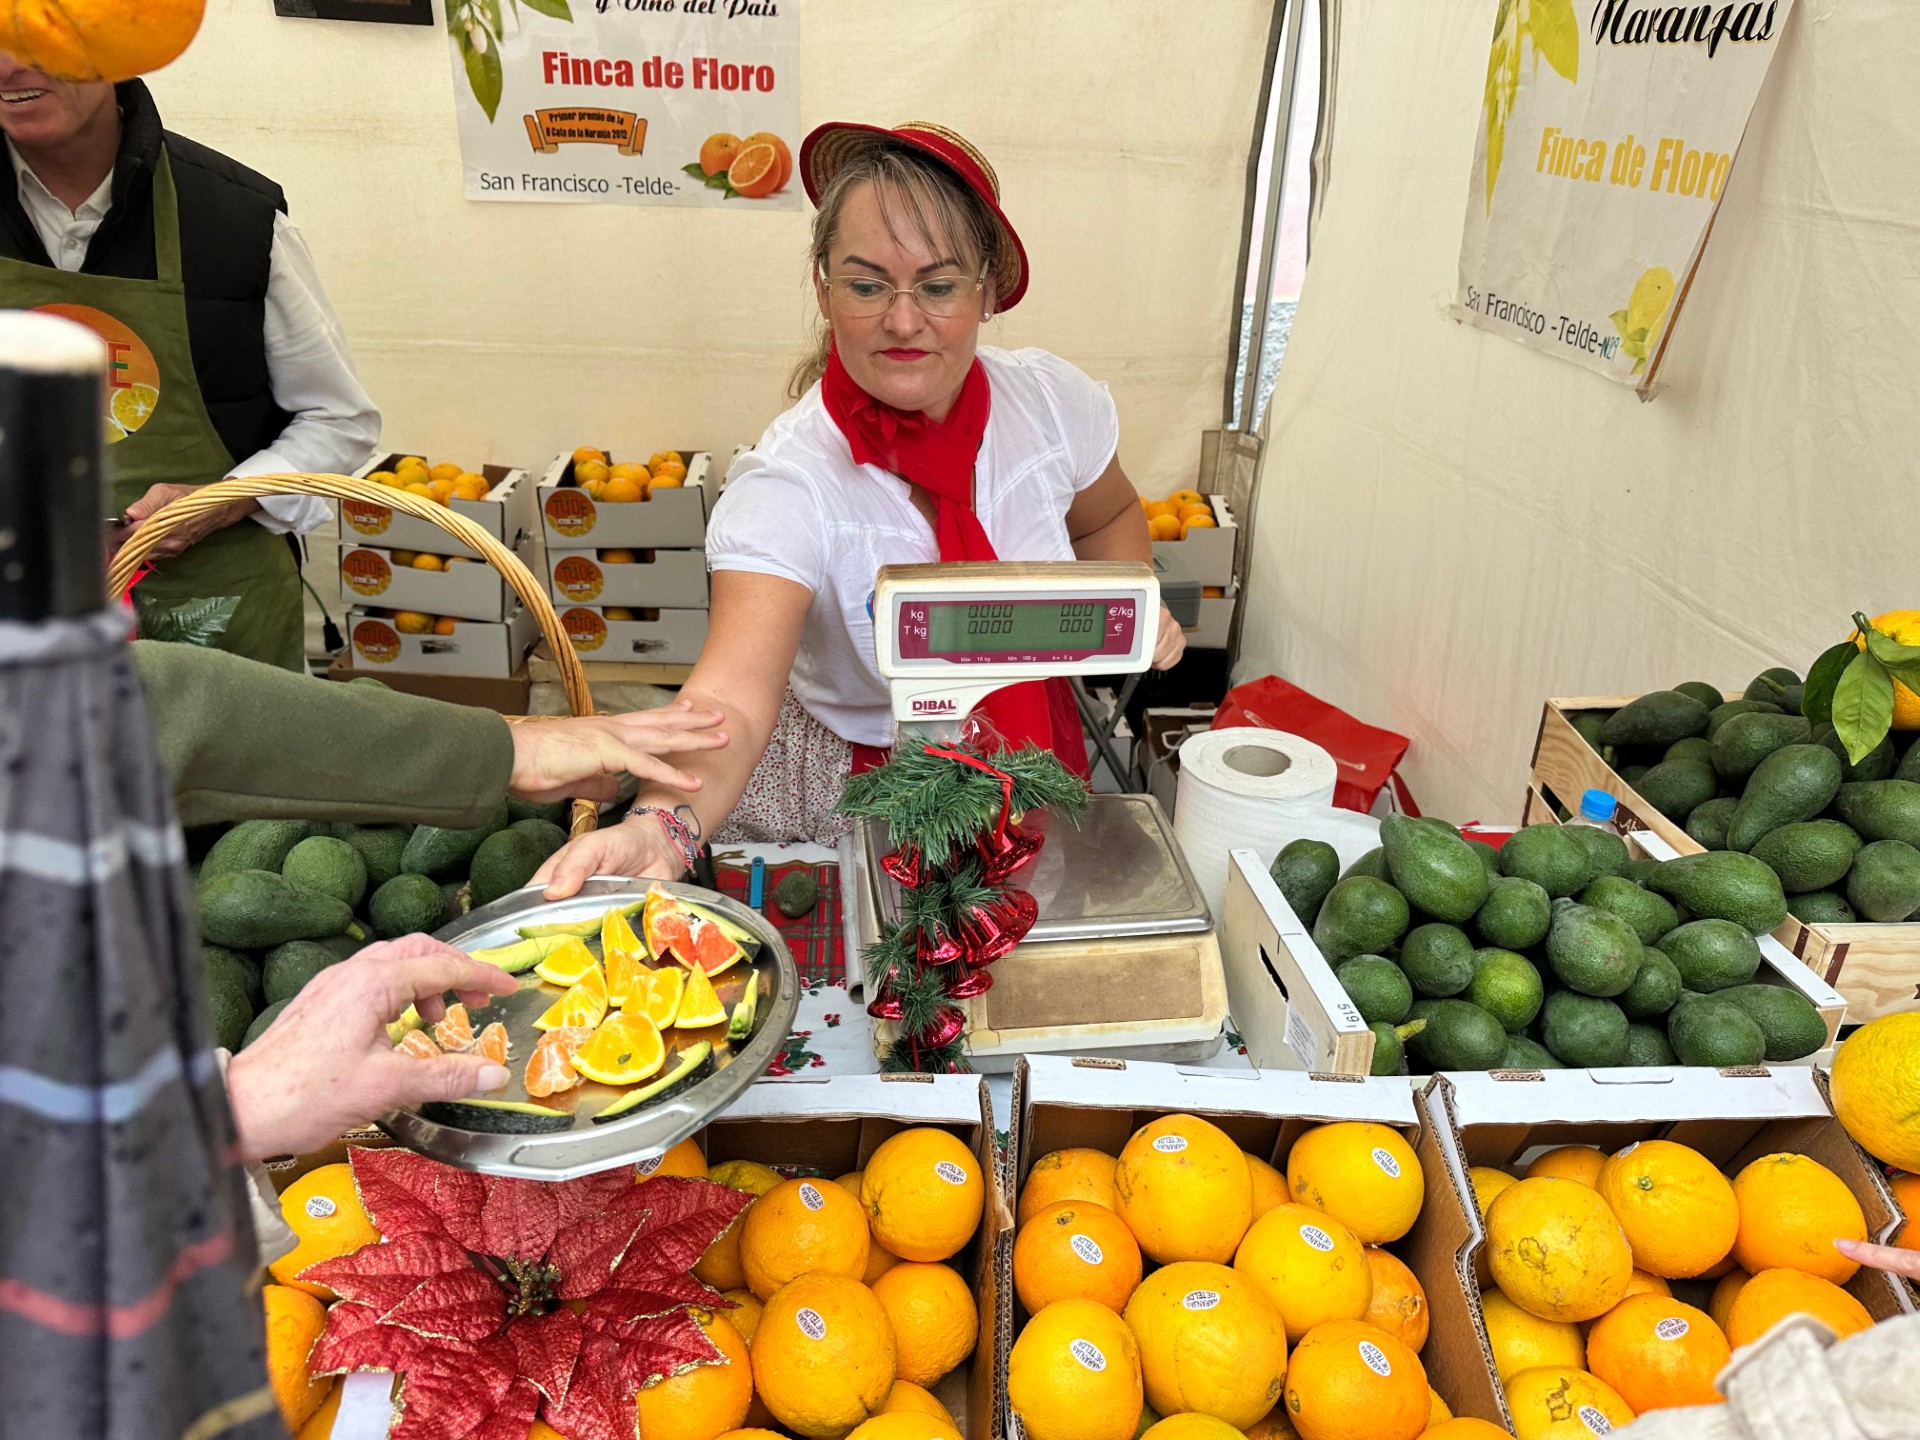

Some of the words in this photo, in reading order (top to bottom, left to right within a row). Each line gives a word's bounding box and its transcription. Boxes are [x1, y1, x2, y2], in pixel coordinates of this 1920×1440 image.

[1590, 0, 1779, 58] Naranjas
[542, 51, 634, 87] Finca
[643, 56, 684, 89] de
[692, 57, 775, 93] Floro
[548, 112, 577, 123] Primer
[578, 111, 605, 122] premio
[606, 113, 615, 124] de
[617, 116, 624, 125] la
[551, 127, 567, 137] Cata
[568, 128, 576, 137] de
[577, 128, 584, 137] la
[585, 128, 611, 139] Naranja
[612, 129, 628, 140] 2012
[1536, 127, 1607, 183] Finca
[1610, 135, 1646, 189] de
[1649, 138, 1731, 202] Floro
[480, 173, 515, 191] San
[521, 174, 609, 194] Francisco
[616, 177, 680, 196] -Telde-
[1465, 285, 1481, 313] San
[1485, 293, 1546, 334] Francisco
[911, 609, 924, 621] kg
[1109, 607, 1134, 618] €/kg
[904, 625, 911, 635] T
[914, 625, 927, 637] kg
[1114, 623, 1123, 632] €
[912, 700, 956, 710] DIBAL
[1323, 1236, 1331, 1245] DE
[1093, 1248, 1101, 1258] DE
[1095, 1353, 1104, 1364] DE
